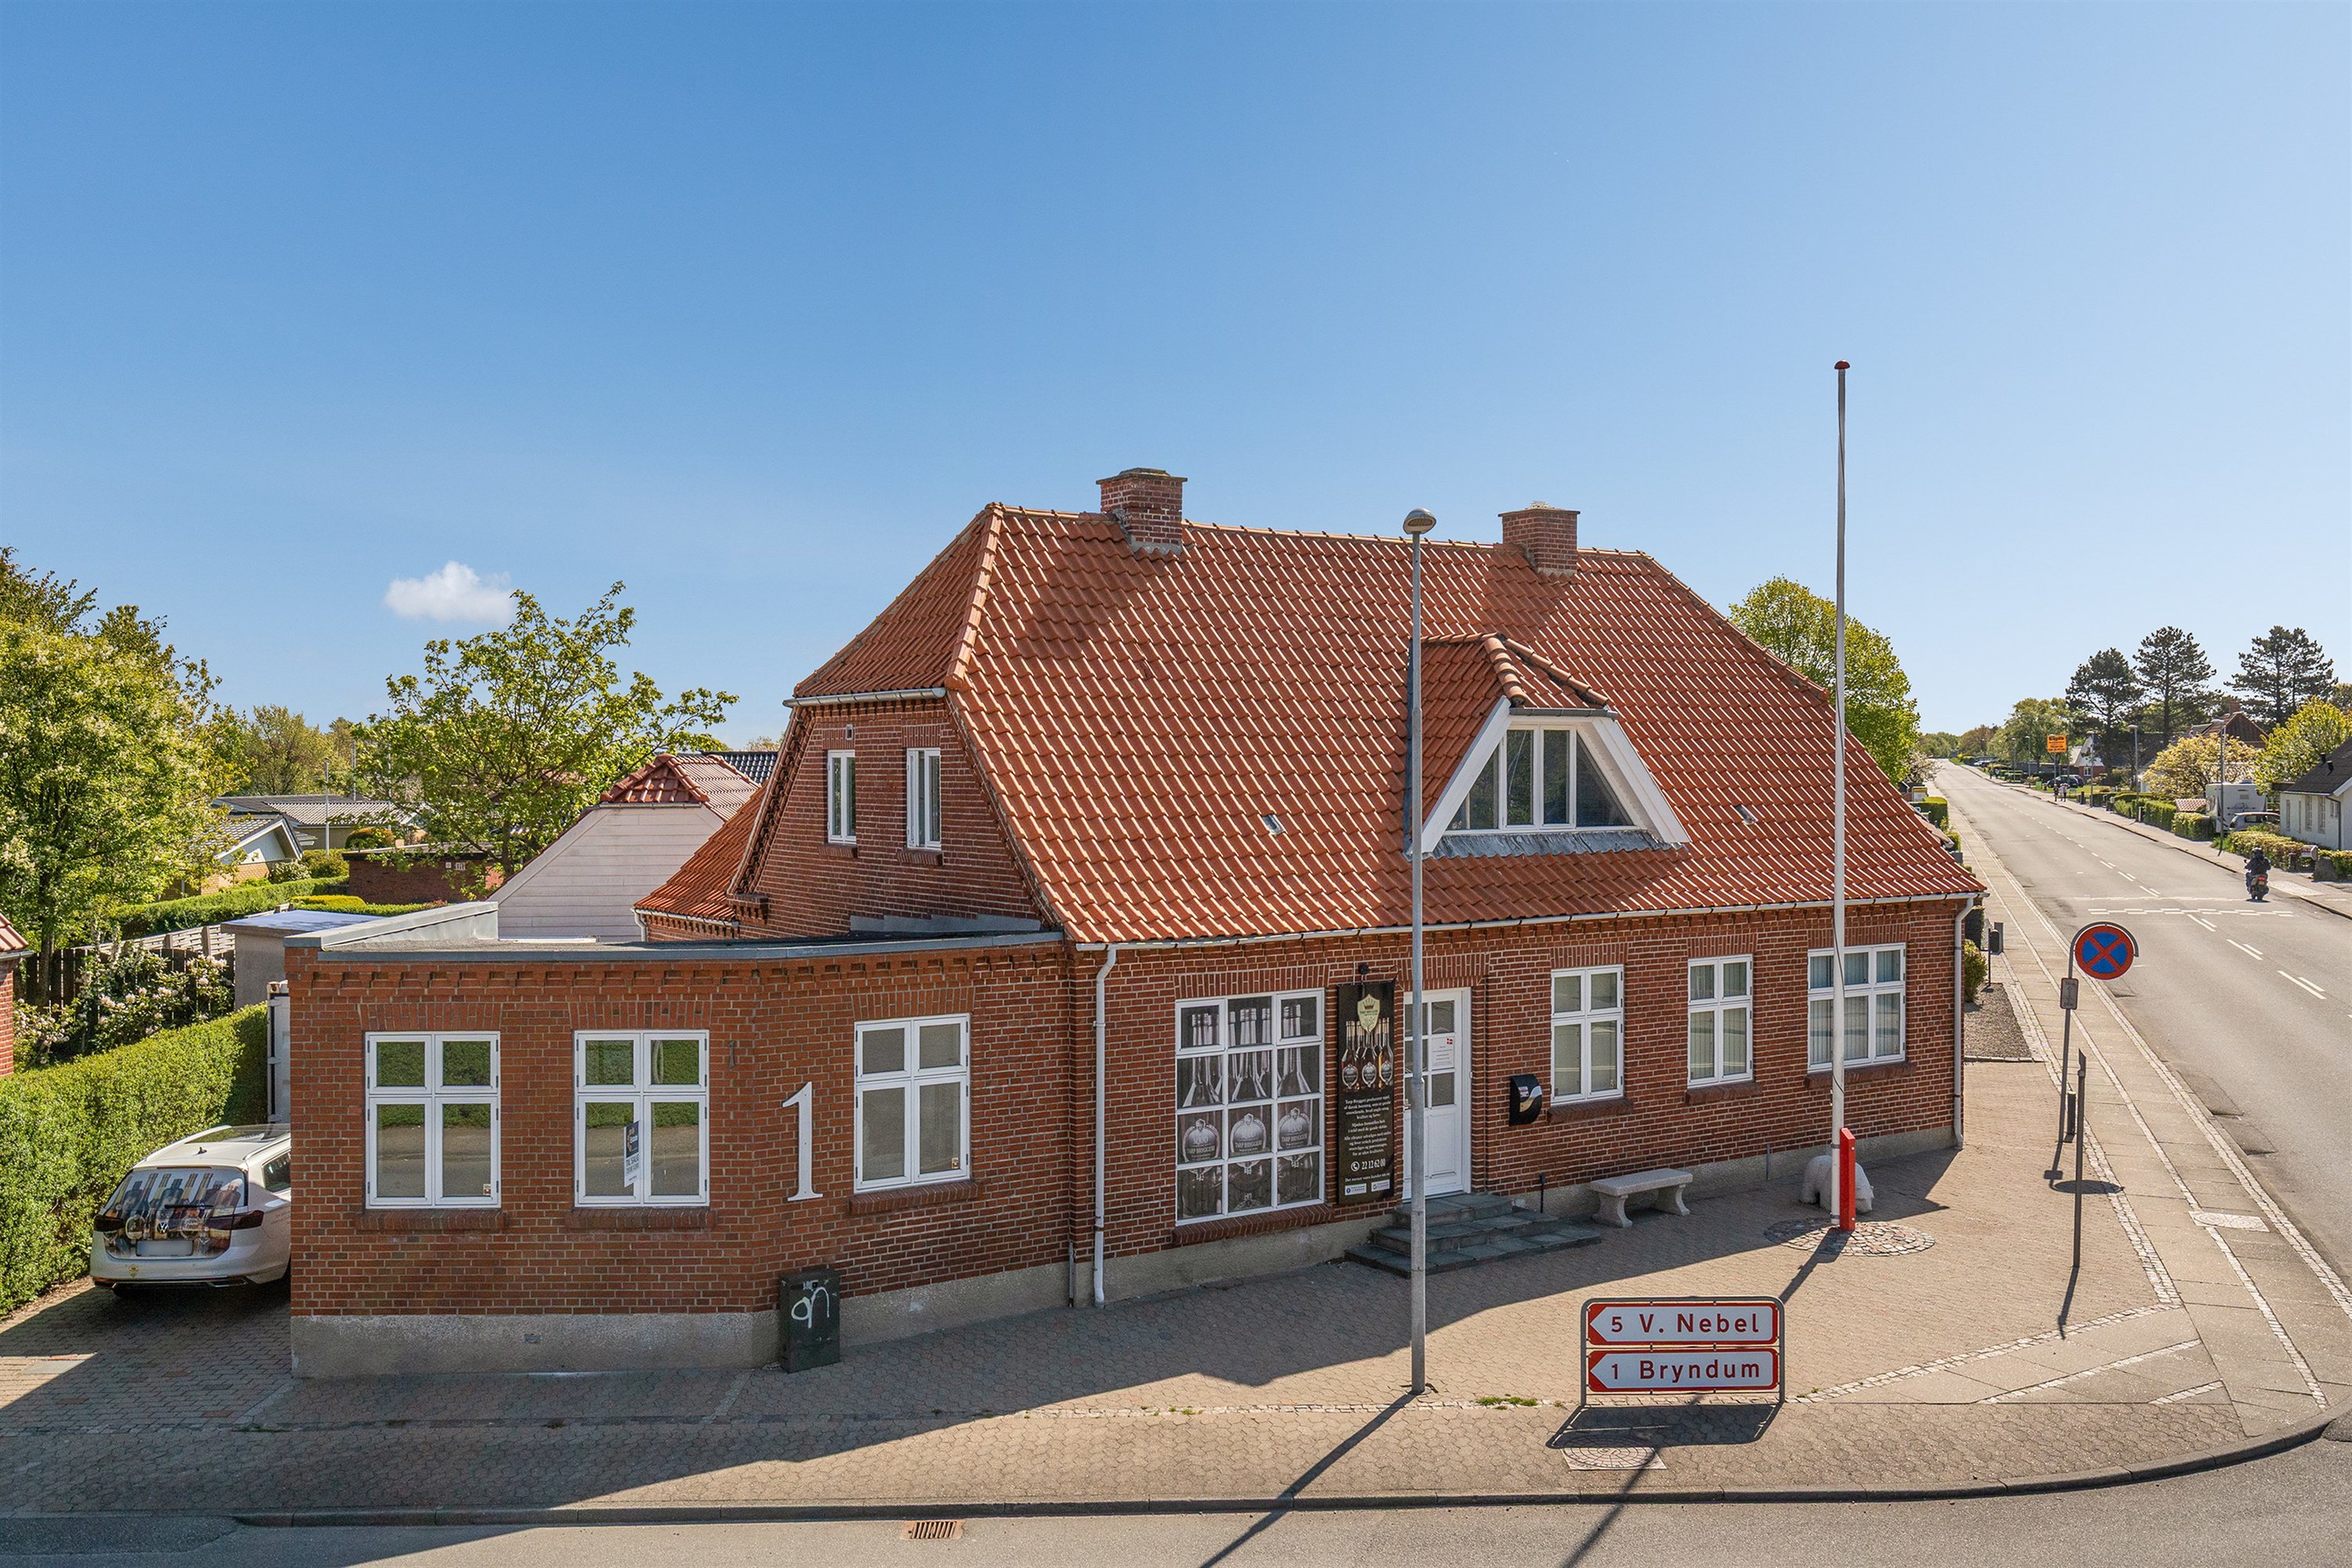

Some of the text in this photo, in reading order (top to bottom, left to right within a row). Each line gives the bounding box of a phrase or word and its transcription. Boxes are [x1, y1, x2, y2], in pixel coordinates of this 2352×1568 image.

[782, 1081, 823, 1202] 1
[1361, 1158, 1386, 1171] 22 12 62 00
[1611, 1313, 1759, 1333] 5 V. Nebel
[1611, 1359, 1760, 1383] 1 Bryndum
